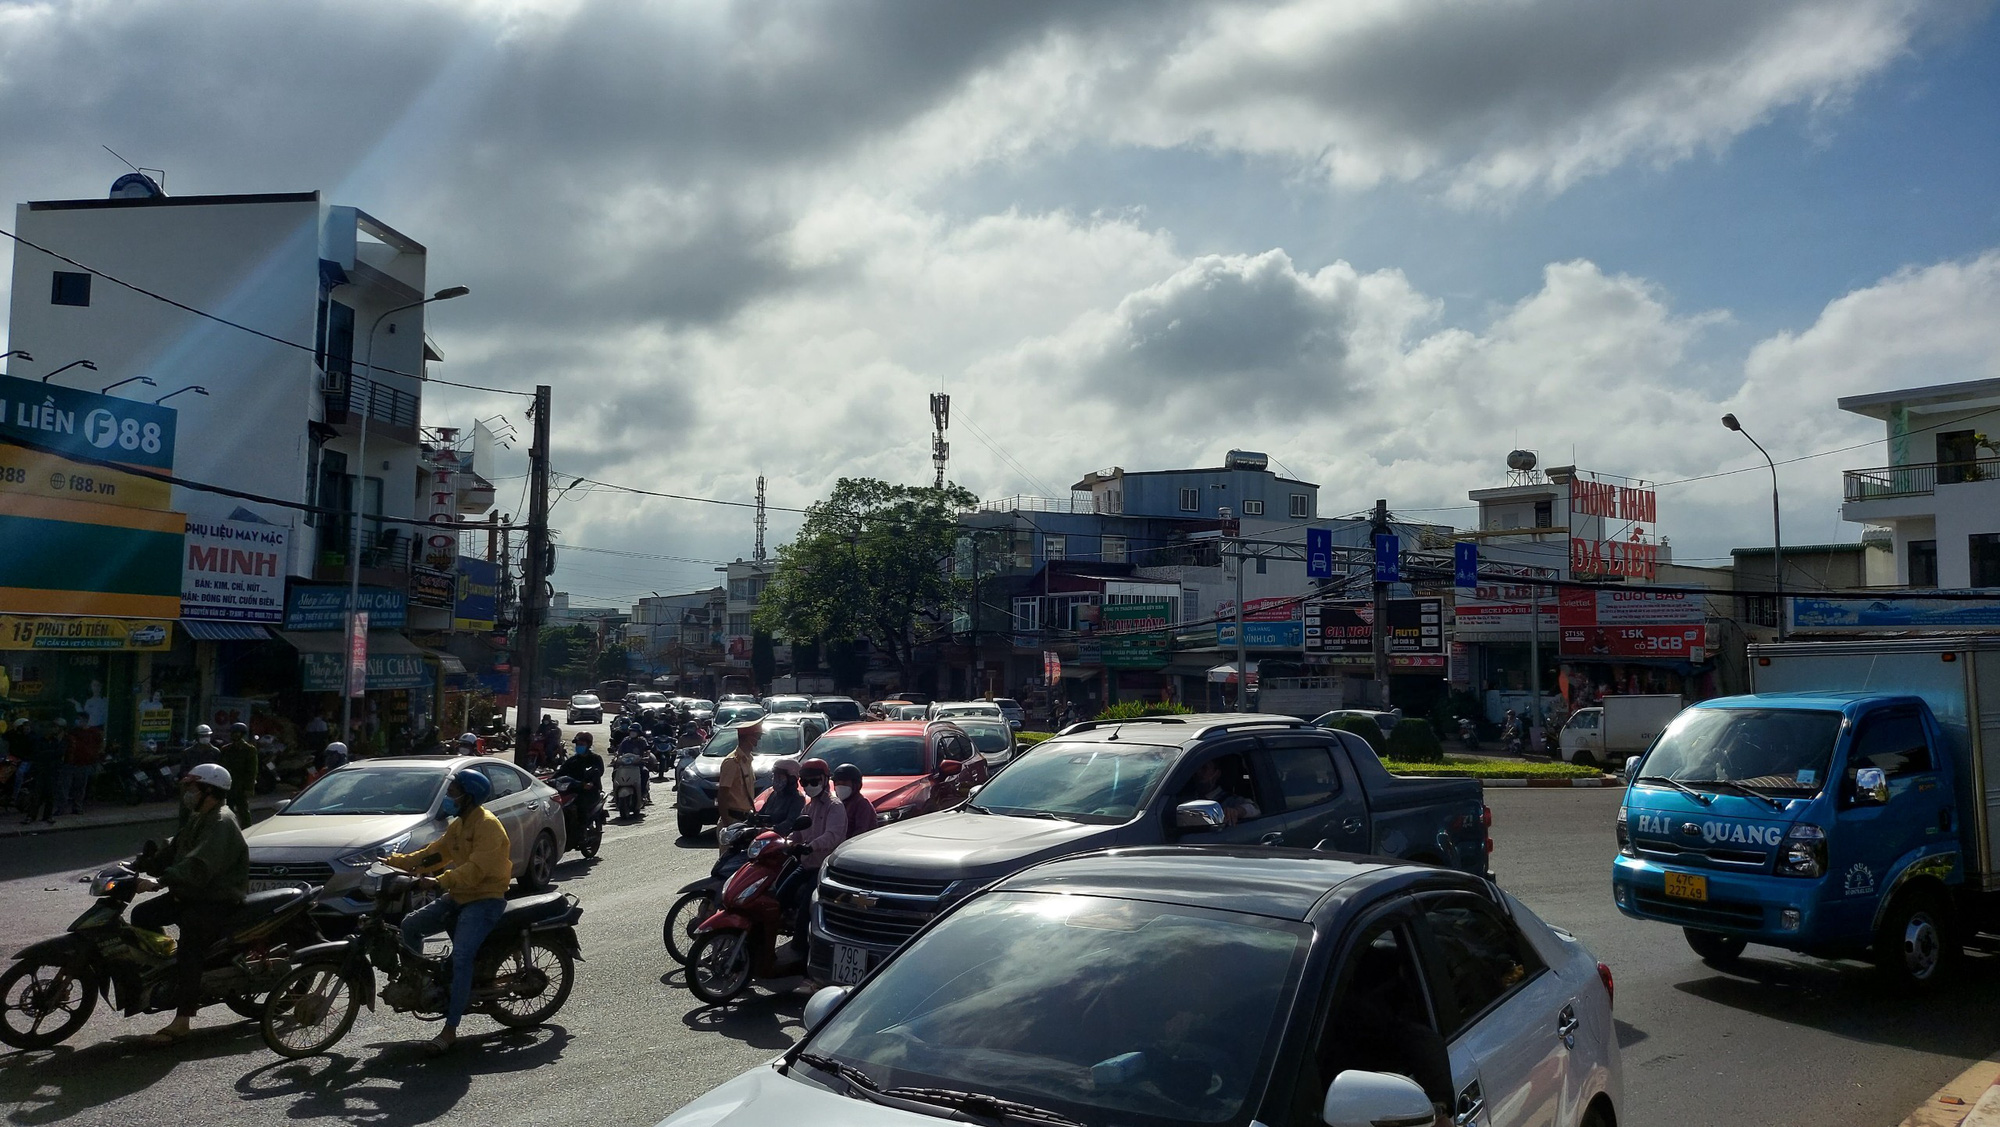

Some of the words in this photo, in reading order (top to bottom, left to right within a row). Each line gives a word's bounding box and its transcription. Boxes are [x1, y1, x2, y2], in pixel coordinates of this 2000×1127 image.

[17, 395, 75, 435] LIỀN
[84, 408, 162, 455] F88
[69, 475, 116, 496] f88.vn
[185, 523, 207, 538] PHỤ
[210, 524, 233, 541] LIỆU
[235, 529, 259, 541] MAY
[188, 544, 277, 577] MINH
[1571, 537, 1601, 573] DA
[181, 591, 200, 603] HẬN:
[1563, 599, 1591, 607] viettel
[13, 621, 34, 642] 15
[1325, 625, 1345, 638] GIA
[1395, 628, 1420, 637] AUTO
[1621, 629, 1645, 639] 15K
[1647, 636, 1683, 650] 3GB
[1702, 820, 1783, 847] QUANG
[1676, 875, 1695, 886] 47C
[1669, 885, 1702, 899] 227.49
[840, 946, 859, 966] 79C
